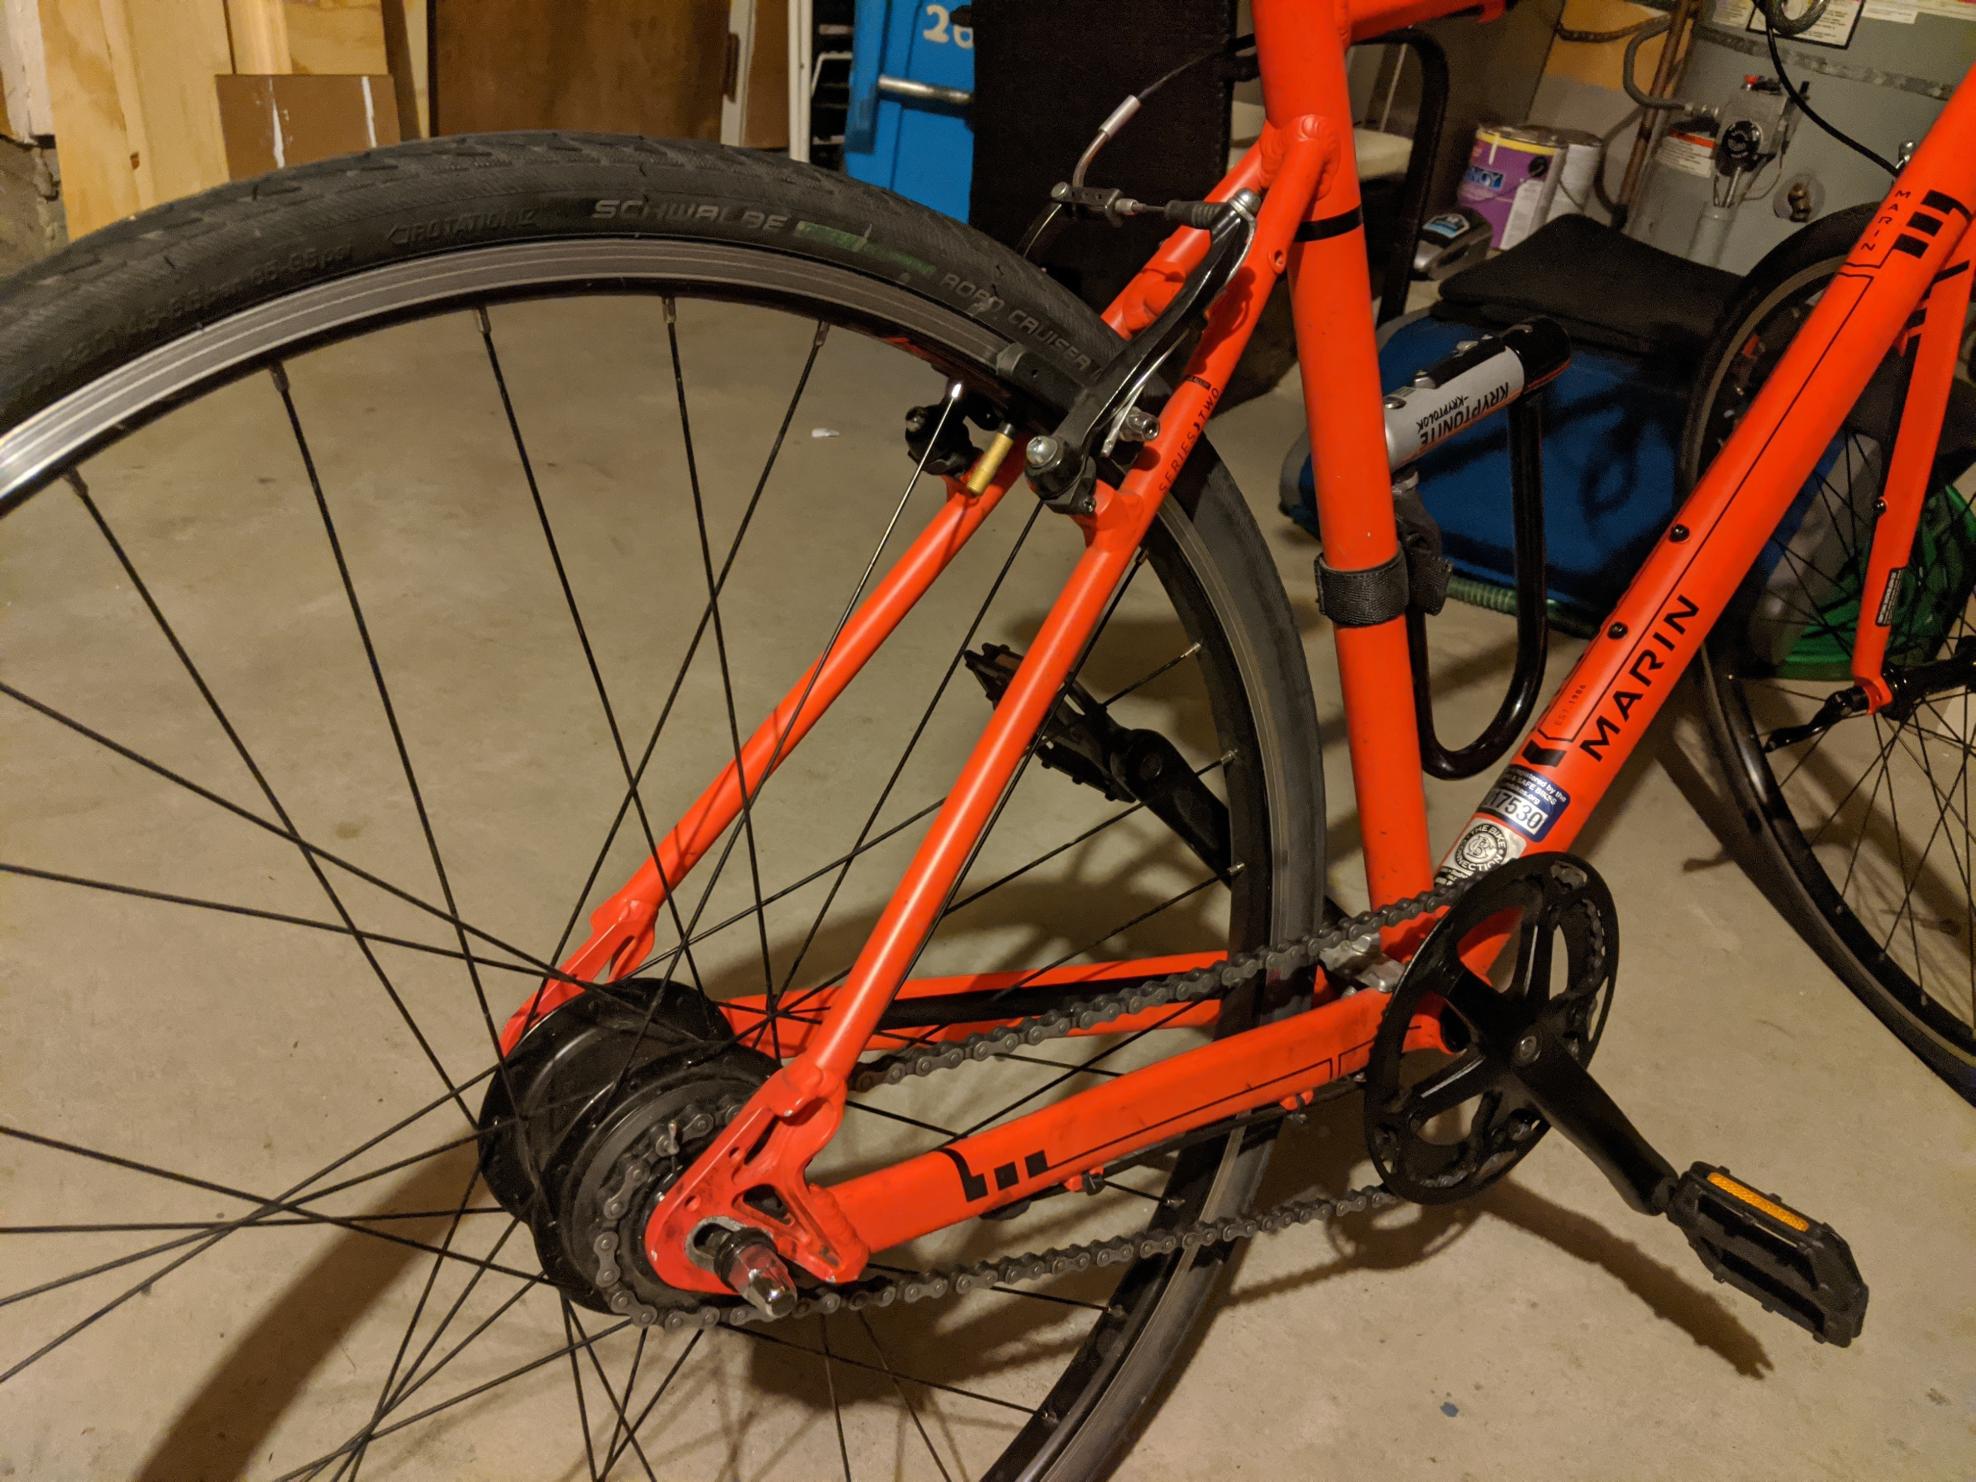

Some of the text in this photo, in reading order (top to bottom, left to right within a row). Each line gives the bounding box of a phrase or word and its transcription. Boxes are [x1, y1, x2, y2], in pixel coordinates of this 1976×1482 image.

[592, 199, 789, 231] SCHWALBE
[1861, 189, 1911, 251] MARIN
[1008, 309, 1092, 370] CRUISER
[1198, 387, 1222, 423] TWO
[1420, 382, 1510, 445] KRYPTONITE
[1580, 594, 1700, 762] MARIN
[1488, 827, 1506, 849] BIKE
